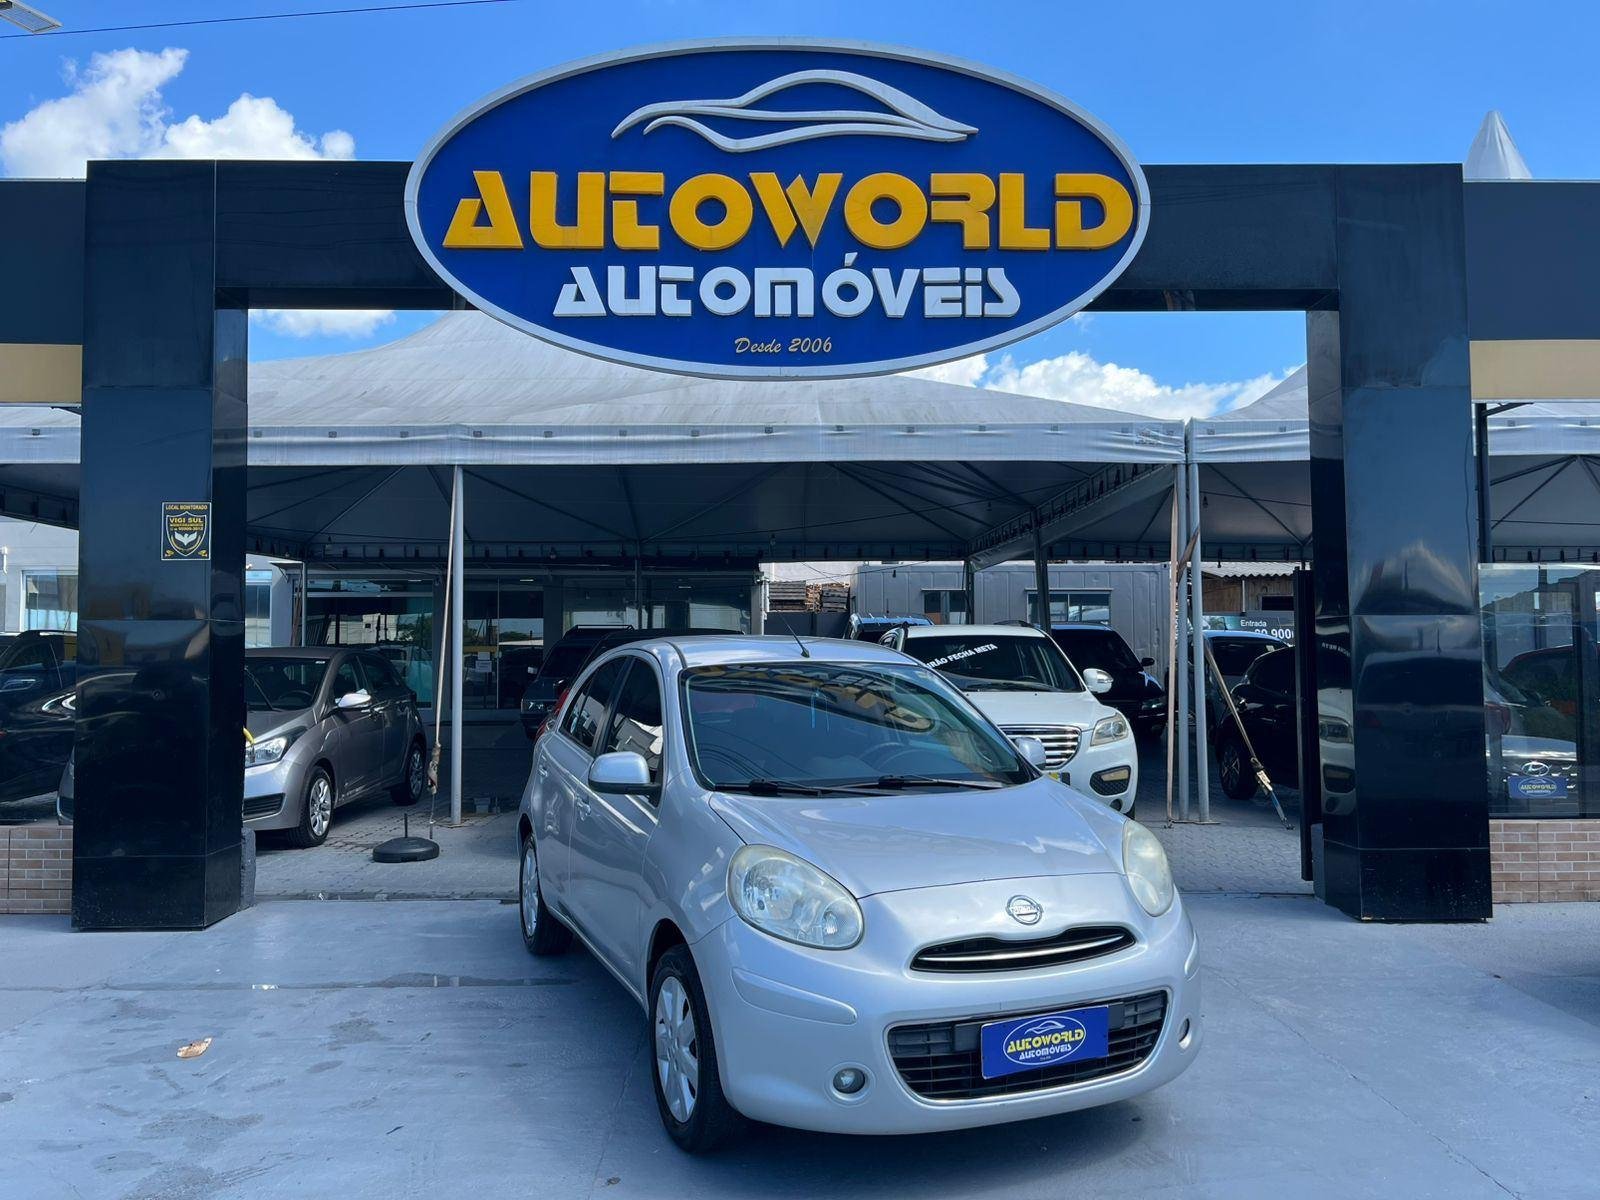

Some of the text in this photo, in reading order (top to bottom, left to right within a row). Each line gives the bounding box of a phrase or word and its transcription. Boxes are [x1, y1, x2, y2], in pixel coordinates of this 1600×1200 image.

[442, 170, 1134, 250] AUTOWORLD
[553, 252, 1021, 318] AUTOMÓVEIS
[734, 336, 832, 353] Desde 2006
[1240, 619, 1267, 627] Entrada
[947, 649, 976, 662] FECHA
[973, 643, 998, 654] META
[1007, 1029, 1085, 1053] AUTOWORLD
